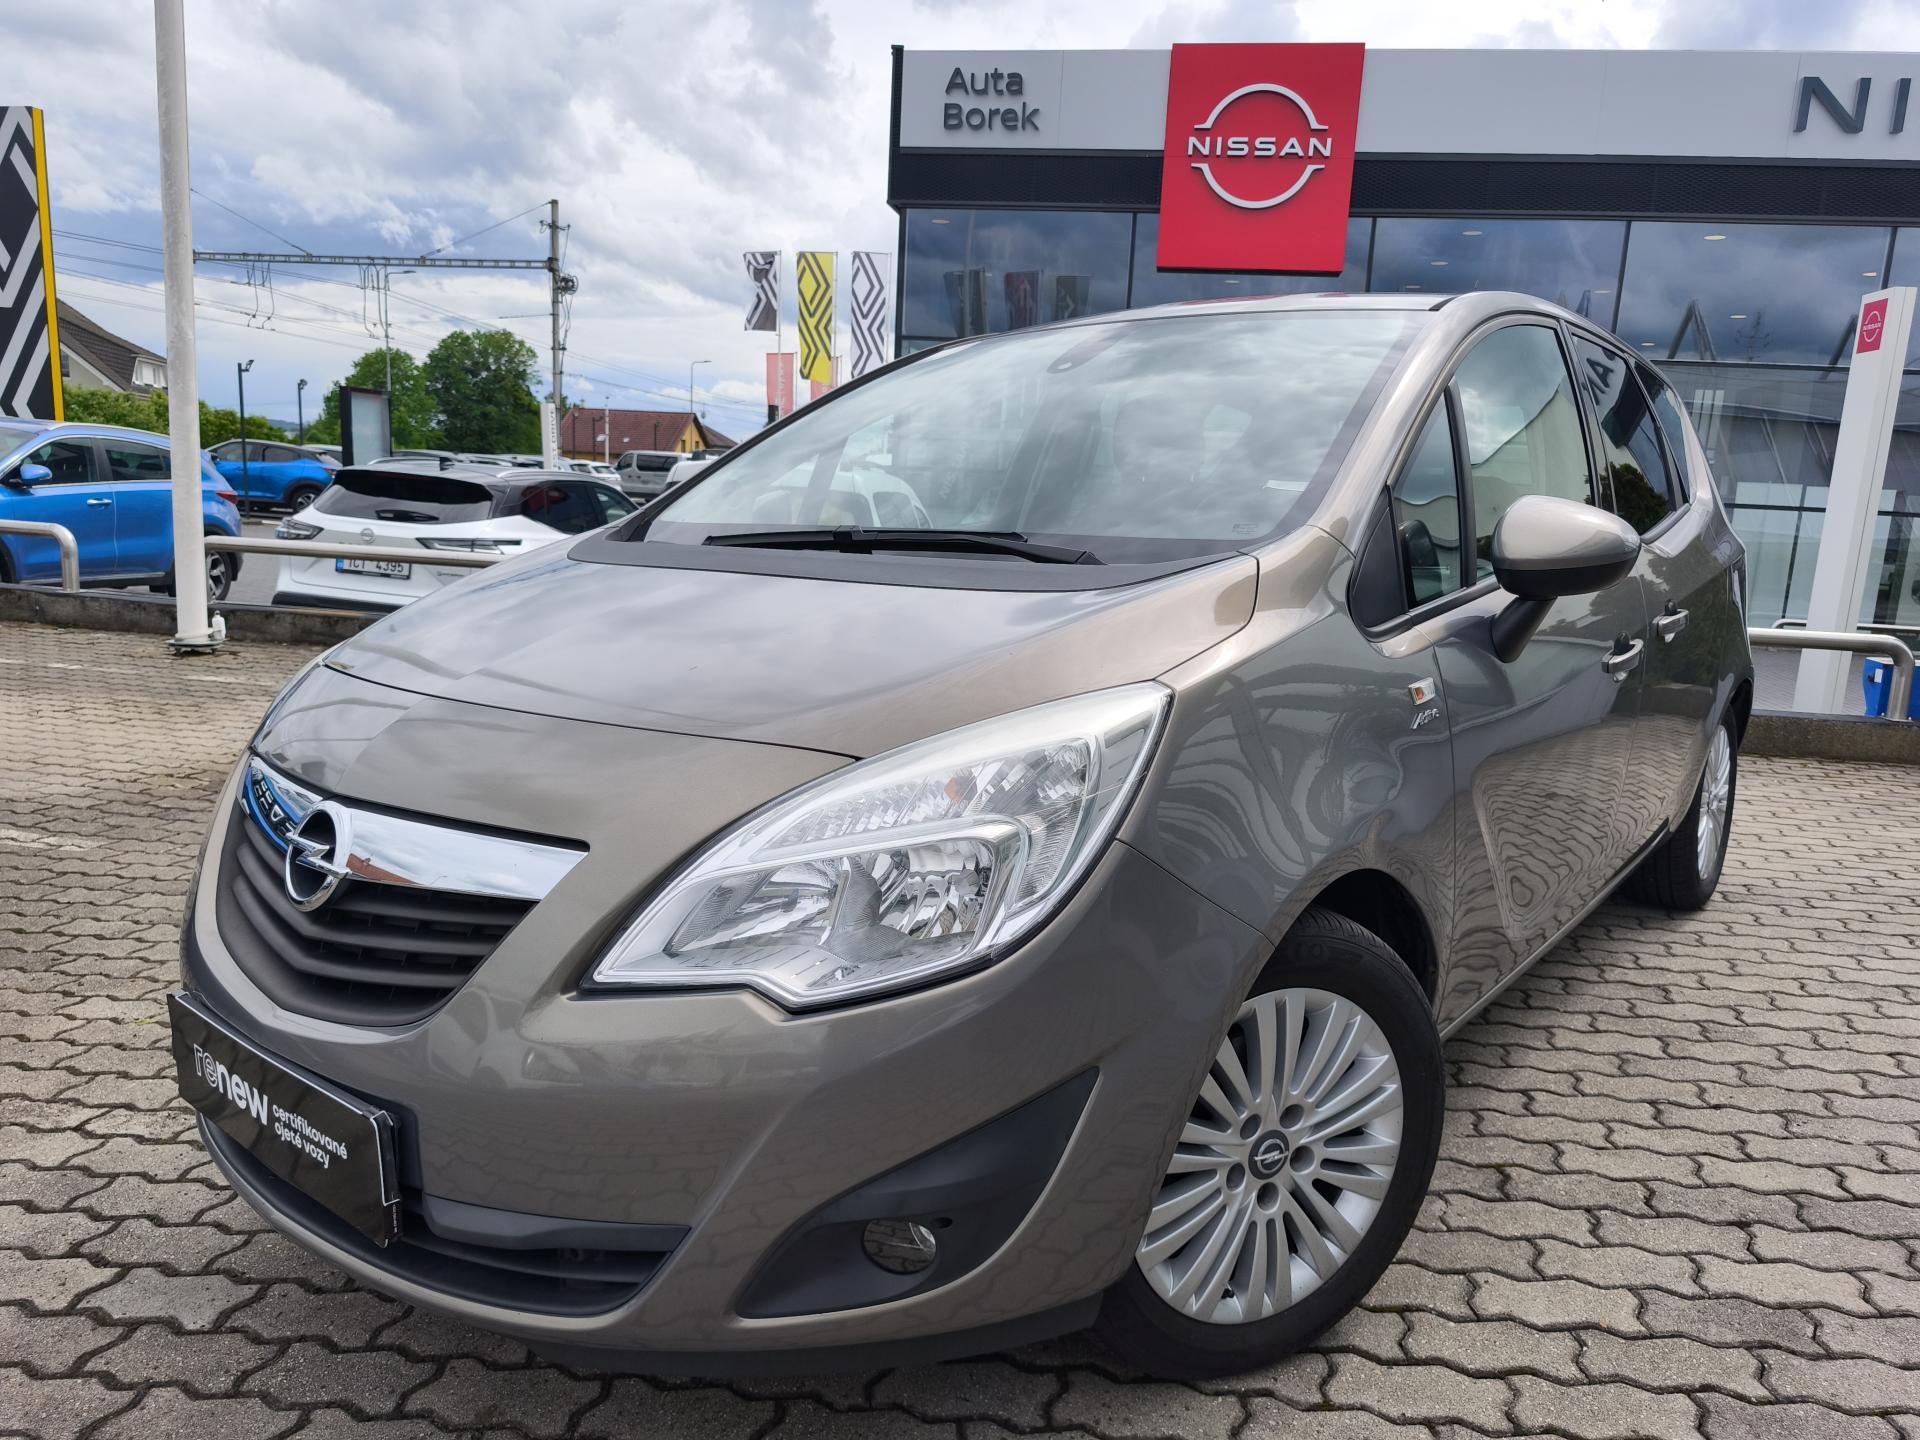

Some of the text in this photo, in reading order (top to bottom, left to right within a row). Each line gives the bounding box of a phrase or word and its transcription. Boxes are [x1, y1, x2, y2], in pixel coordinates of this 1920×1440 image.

[945, 67, 1023, 96] Auta
[944, 101, 1040, 131] Borek
[1187, 136, 1333, 158] NISSAN
[375, 560, 404, 573] 4395
[193, 1043, 269, 1126] renew
[272, 1104, 348, 1160] certifikované
[274, 1122, 331, 1169] ojeté vozy
